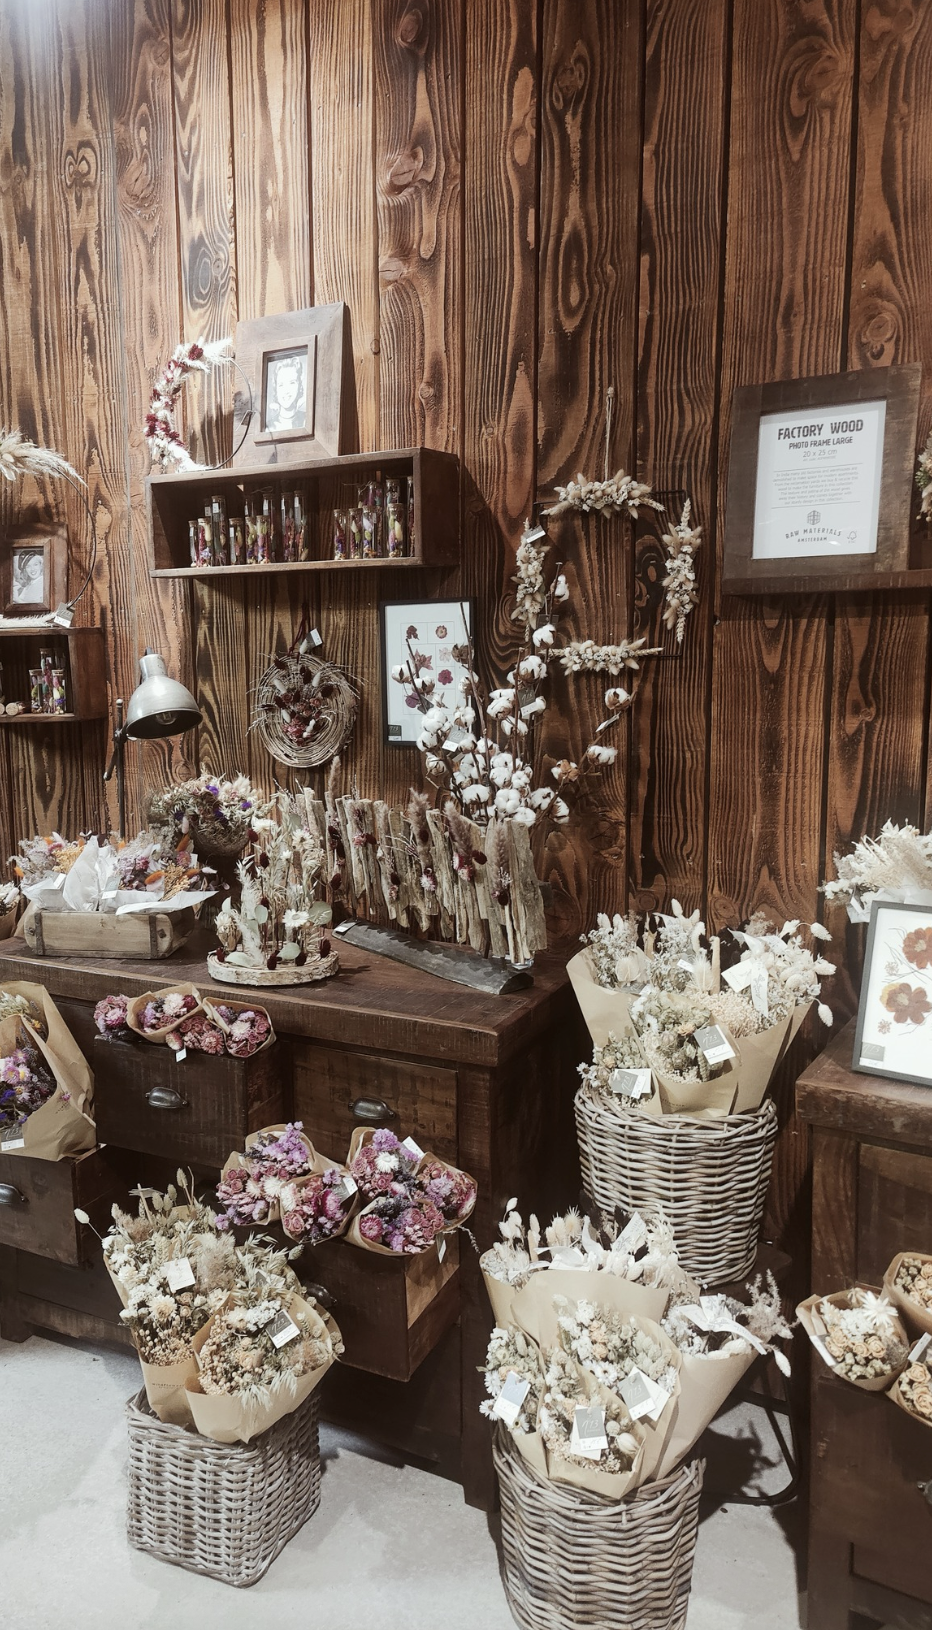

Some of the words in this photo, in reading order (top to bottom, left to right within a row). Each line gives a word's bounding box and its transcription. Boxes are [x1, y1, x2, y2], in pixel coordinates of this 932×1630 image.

[778, 424, 823, 440] FACTORY
[830, 419, 863, 434] WOOD
[789, 441, 808, 450] PHOTO
[810, 438, 831, 448] FRAME
[832, 436, 853, 445] LARGE
[785, 530, 799, 539] RAW
[803, 528, 842, 537] MATERIALS
